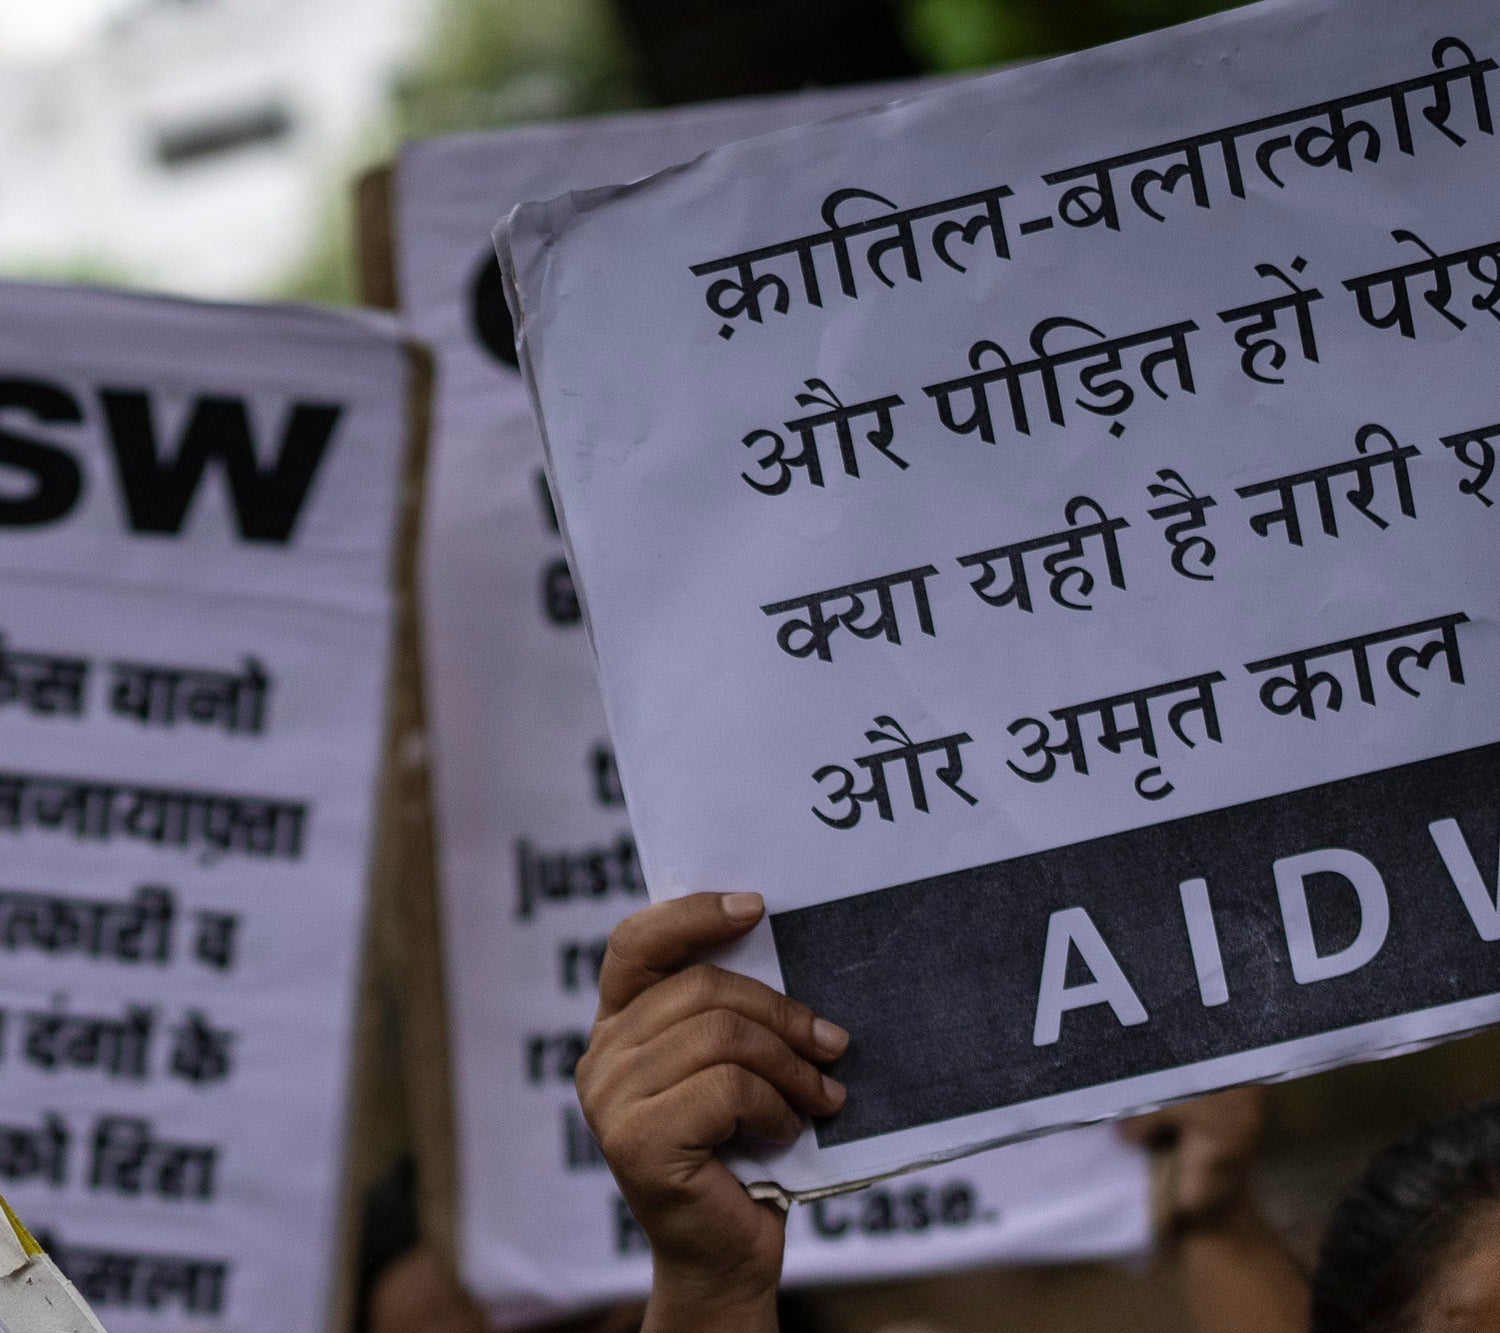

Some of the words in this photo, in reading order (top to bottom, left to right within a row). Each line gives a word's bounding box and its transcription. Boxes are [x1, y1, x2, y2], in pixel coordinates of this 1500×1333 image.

[742, 378, 909, 495] और
[922, 317, 1199, 444] पीड़ित
[1217, 256, 1323, 384] हों
[761, 564, 939, 662] क्या
[957, 496, 1130, 612] यही
[1147, 469, 1217, 580] है
[1235, 424, 1421, 546] नारी
[812, 715, 978, 829] और
[1007, 671, 1226, 800] अमृत
[1245, 612, 1470, 720] काल
[514, 835, 647, 922] just
